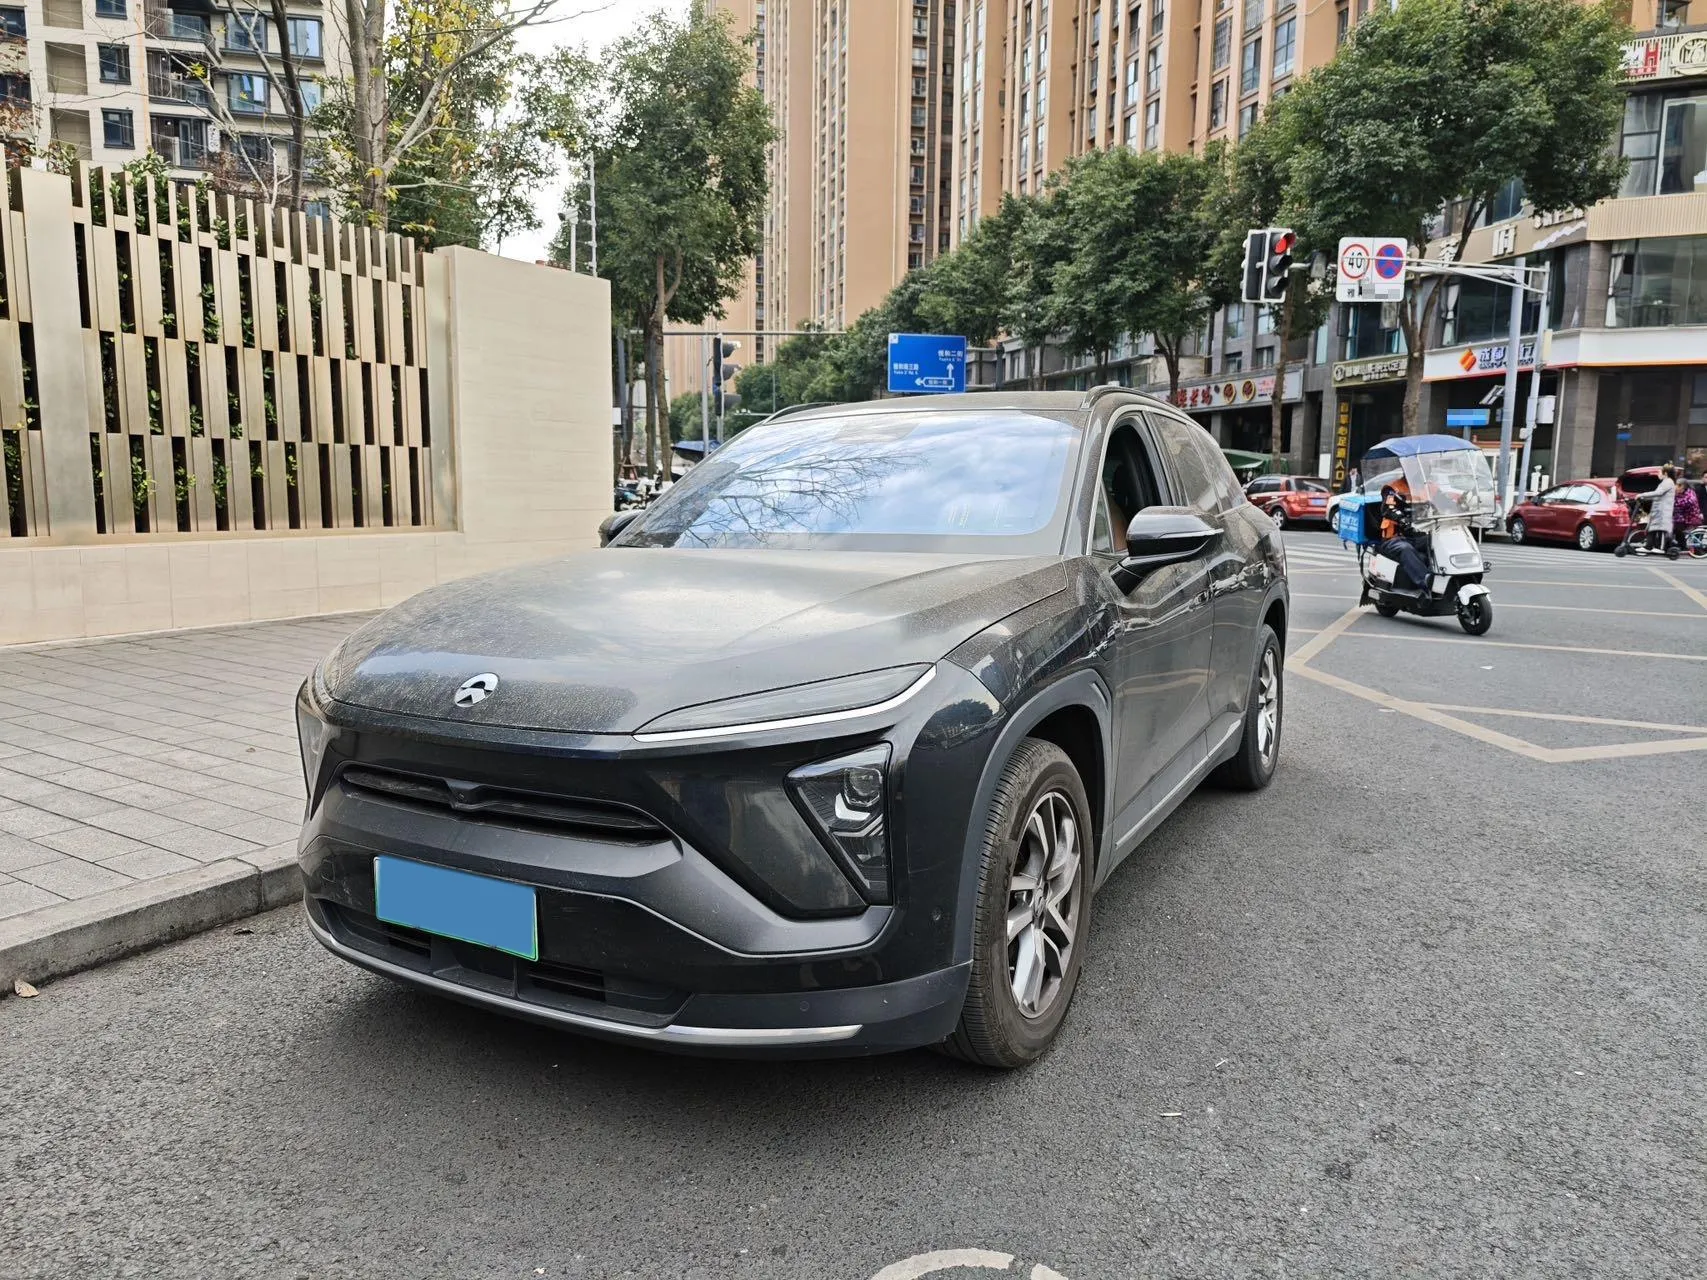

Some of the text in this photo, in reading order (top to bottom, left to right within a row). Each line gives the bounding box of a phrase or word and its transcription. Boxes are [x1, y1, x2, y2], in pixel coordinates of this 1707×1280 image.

[1348, 252, 1363, 269] 40
[1480, 343, 1535, 362] 成都行
